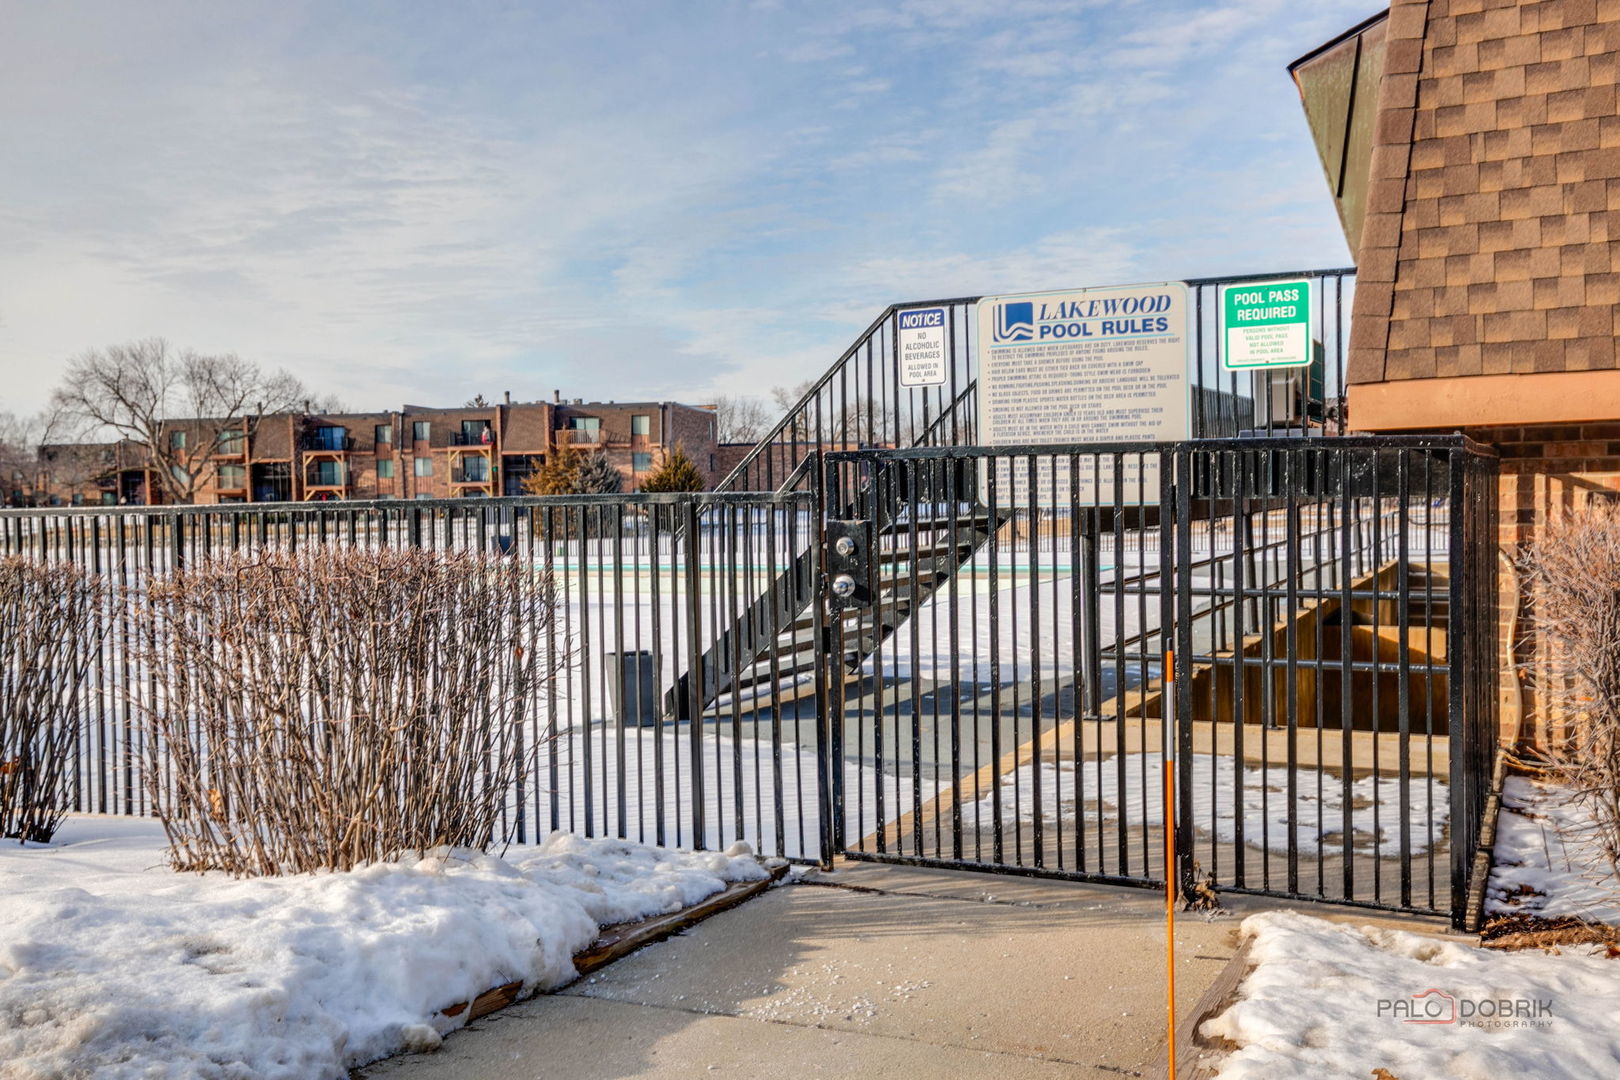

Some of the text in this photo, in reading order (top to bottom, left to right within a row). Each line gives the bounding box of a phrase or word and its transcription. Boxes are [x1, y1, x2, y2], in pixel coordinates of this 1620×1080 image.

[1234, 289, 1300, 306] POOL PASS
[1038, 294, 1171, 321] LAKEWOOD
[1237, 305, 1297, 321] REQUIRED
[902, 313, 942, 328] NOTICE
[1039, 316, 1169, 339] POOL RULES
[917, 331, 927, 340] NO
[905, 341, 940, 350] ALCOHOLIC
[905, 351, 941, 361] BEVERAGES
[908, 363, 931, 371] ALLOWED
